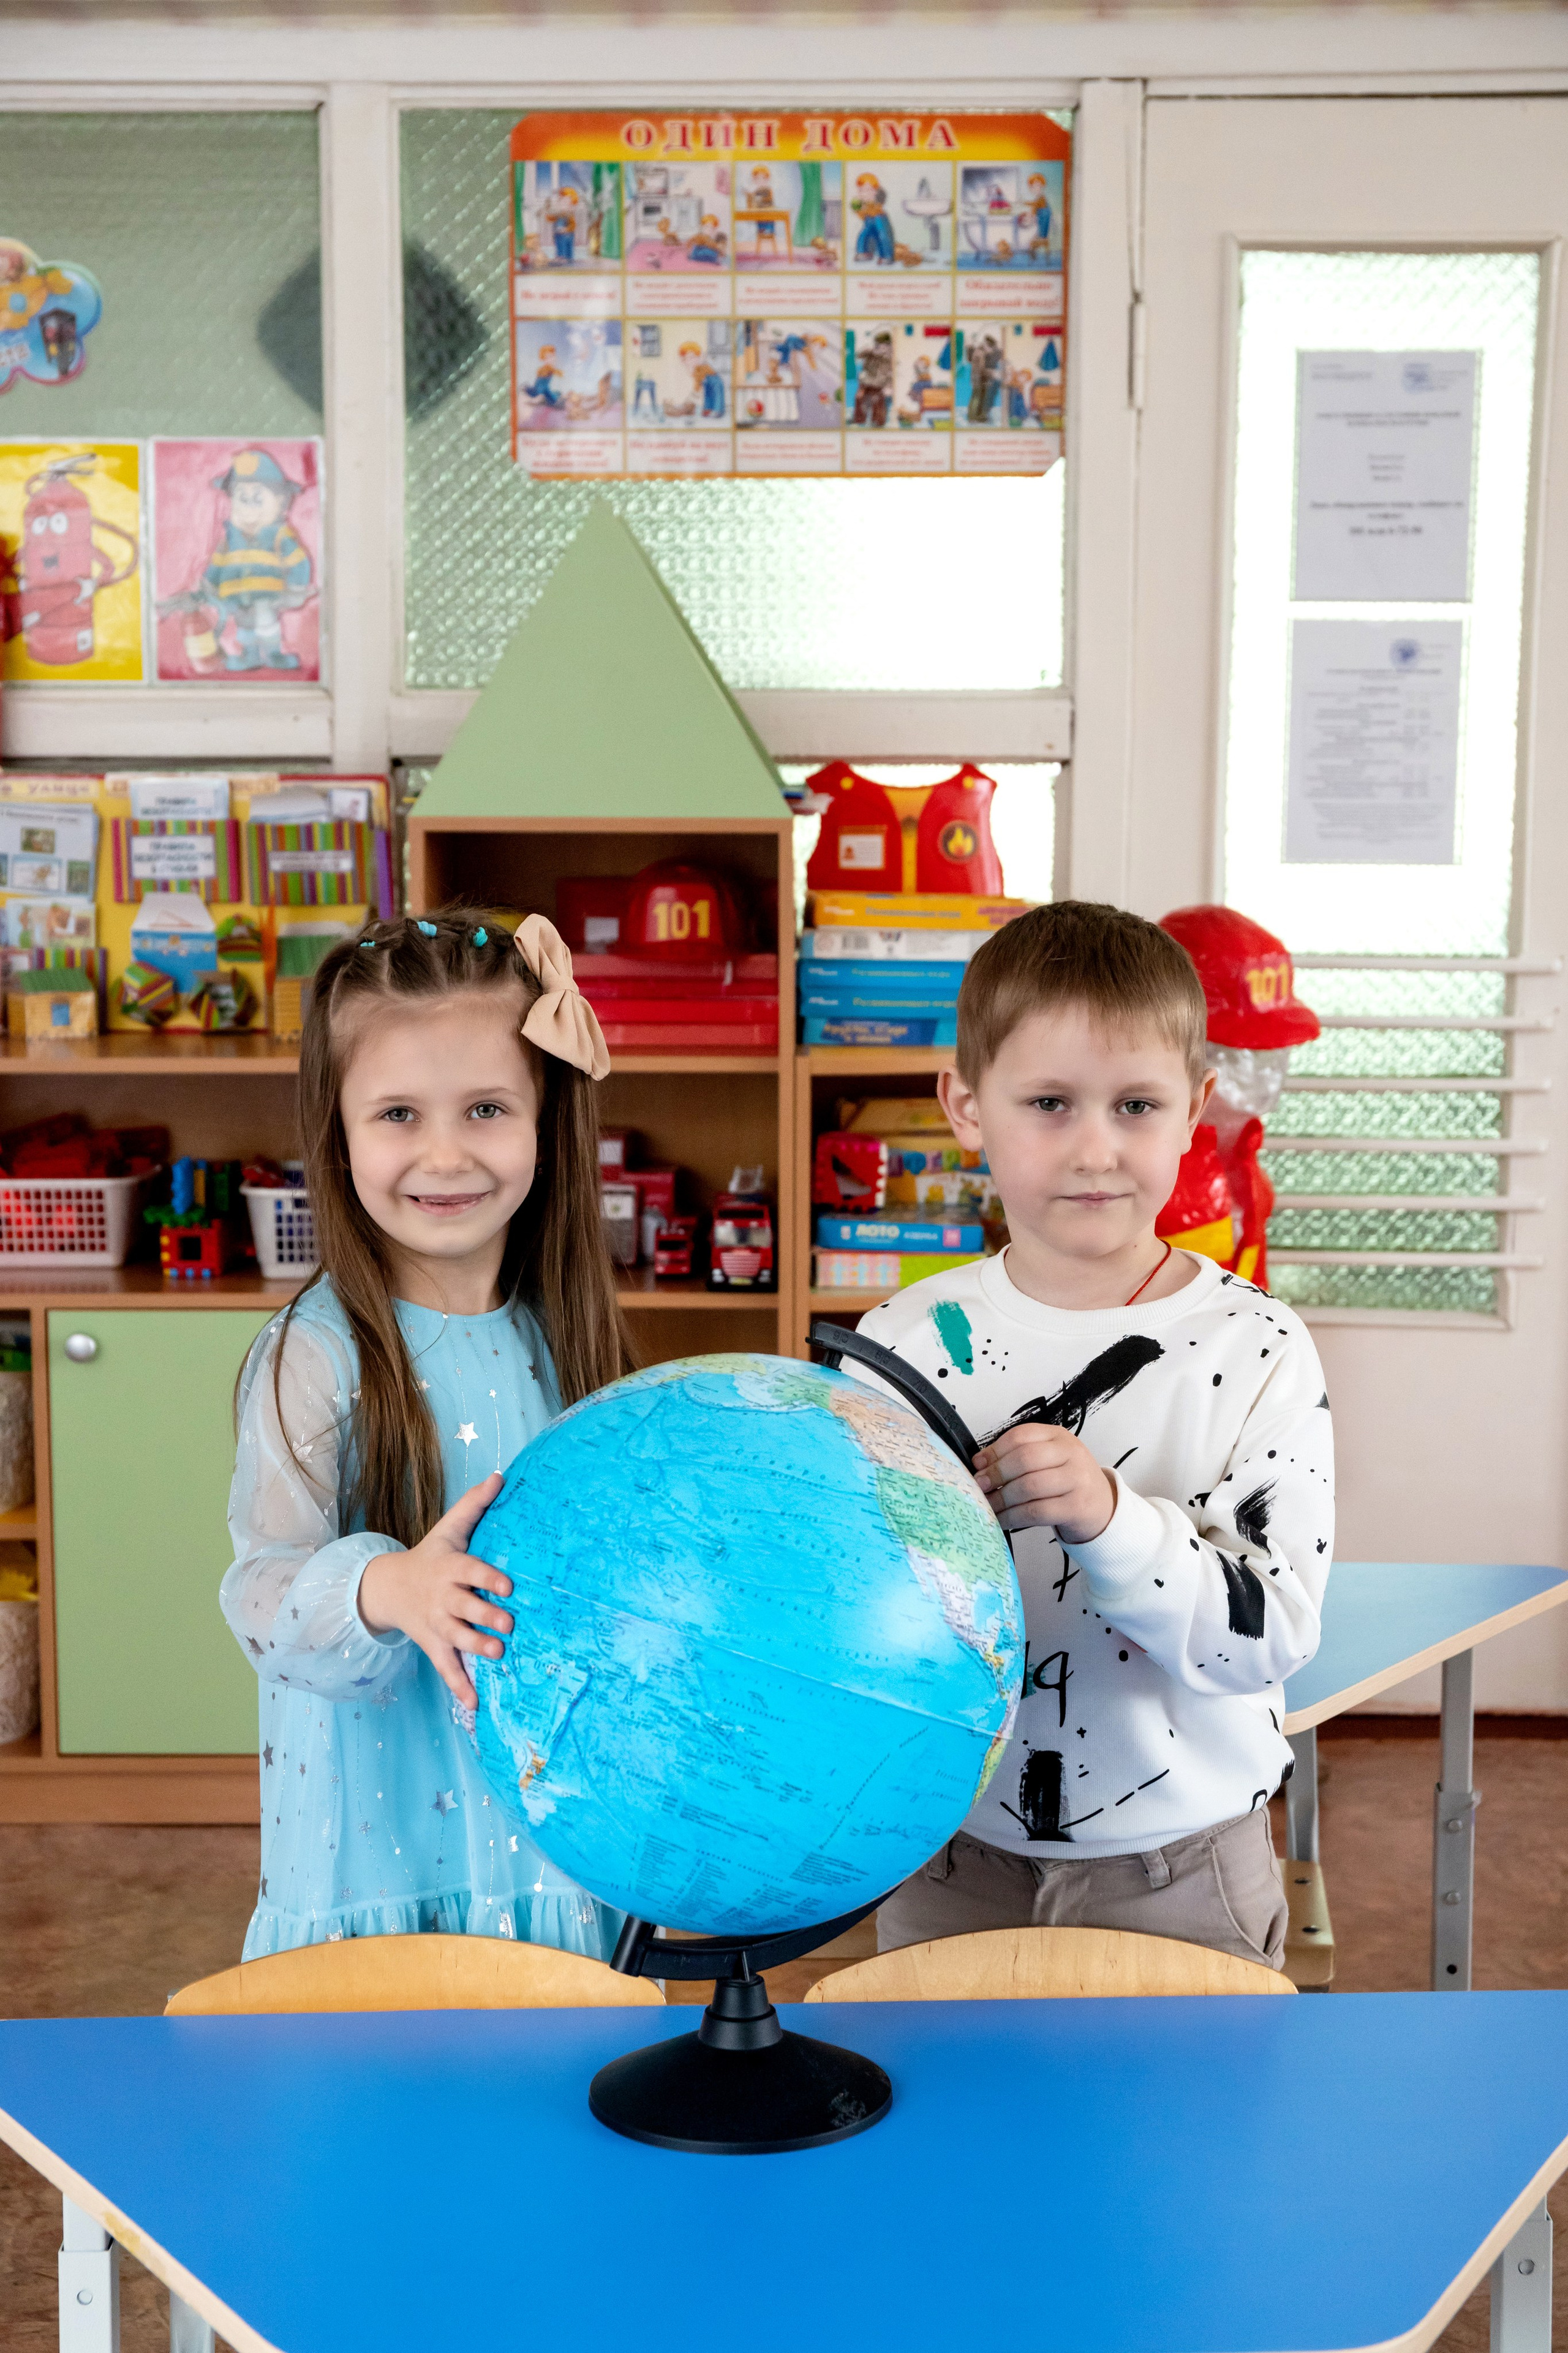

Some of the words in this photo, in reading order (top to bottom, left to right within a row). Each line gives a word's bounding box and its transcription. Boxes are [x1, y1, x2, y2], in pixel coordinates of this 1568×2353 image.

[623, 121, 778, 153] ОДИН
[803, 121, 959, 153] ДОМА
[653, 900, 710, 940] 101
[1246, 963, 1288, 1004] 101
